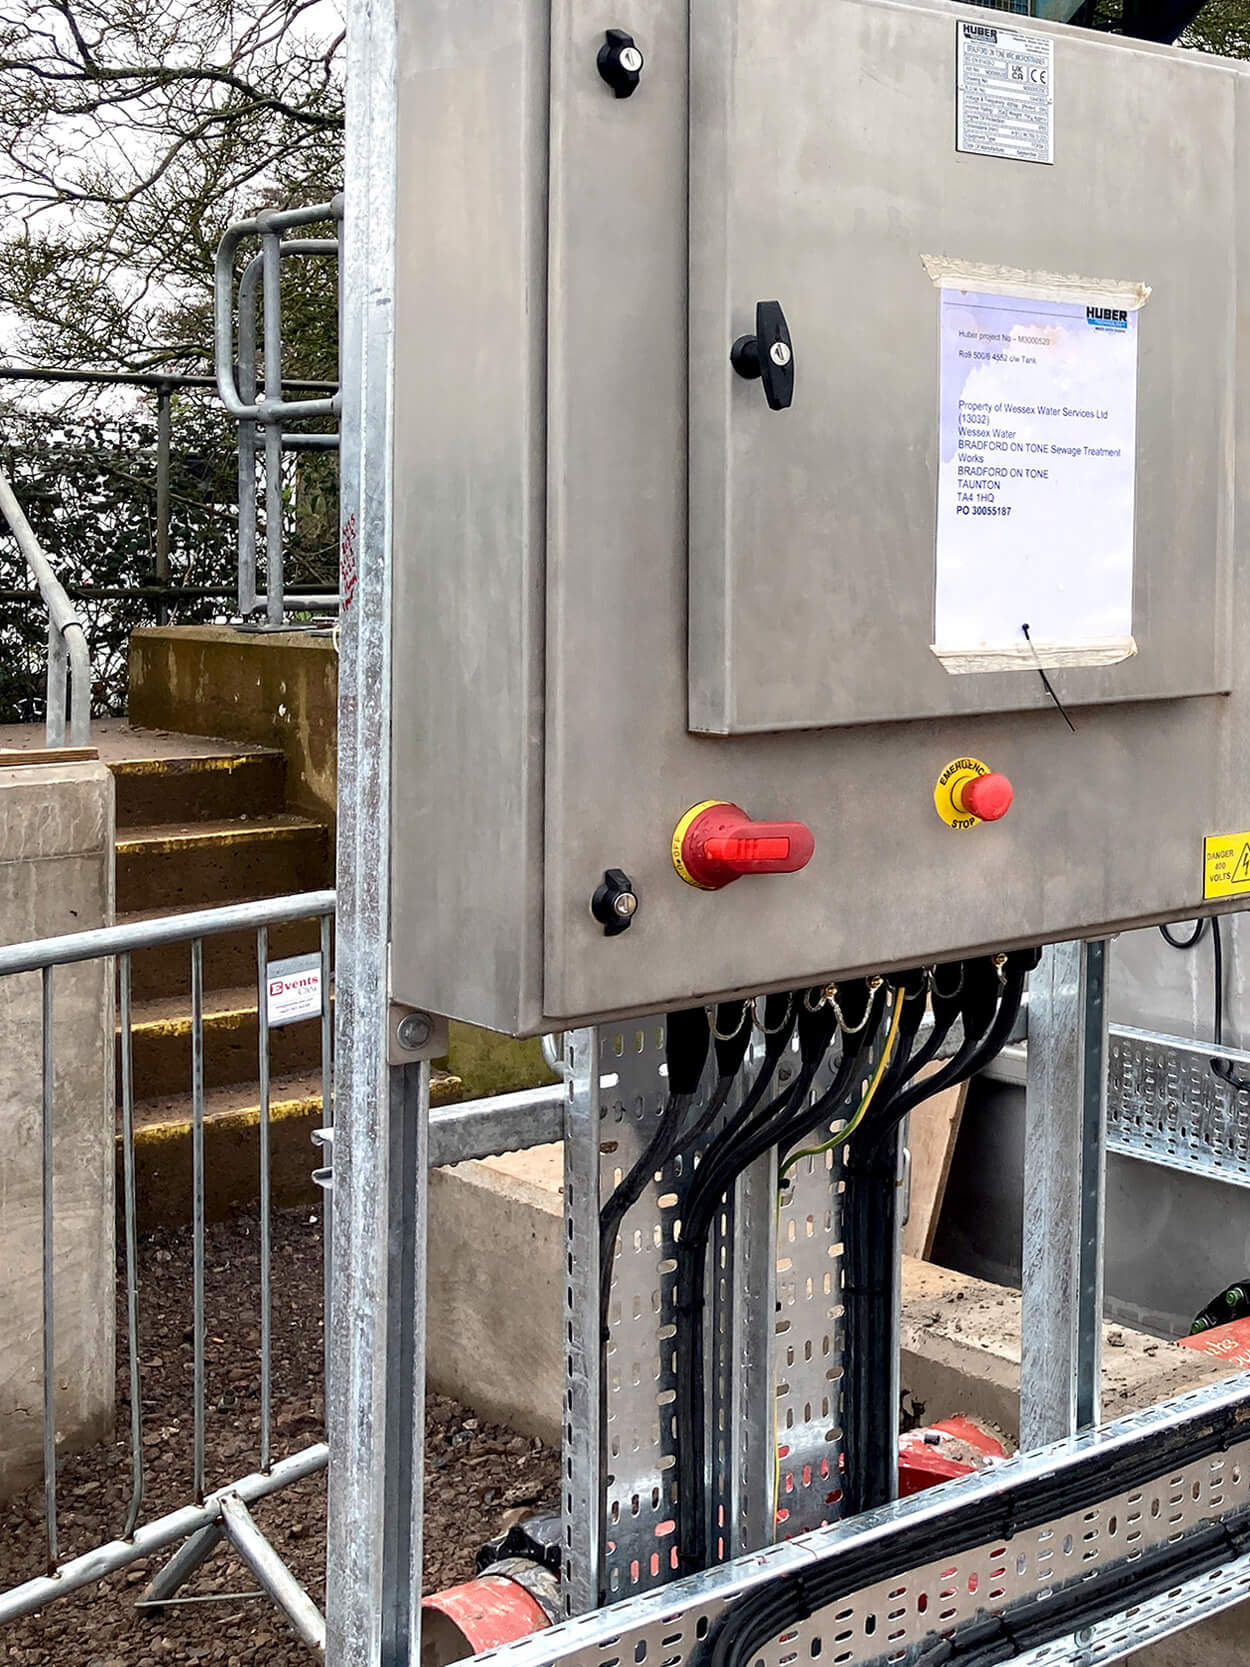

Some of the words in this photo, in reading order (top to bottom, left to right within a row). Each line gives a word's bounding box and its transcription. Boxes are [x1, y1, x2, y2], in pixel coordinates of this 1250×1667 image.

[963, 24, 998, 38] HUBER
[1086, 306, 1128, 322] HUBER
[958, 330, 978, 339] Huber
[979, 333, 1001, 343] project
[958, 400, 992, 414] Property
[994, 402, 1003, 412] of
[1004, 403, 1035, 414] Wessex
[1037, 406, 1060, 416] Water
[1062, 407, 1095, 418] Services
[1096, 409, 1109, 419] Ltd
[958, 412, 990, 426] (13032)
[958, 426, 991, 437] Wessex
[992, 428, 1016, 439] Water
[958, 439, 1009, 452] BRADFORD
[1010, 442, 1023, 452] ON
[1026, 443, 1049, 454] TONE
[1050, 444, 1082, 457] Sewage
[1083, 446, 1121, 457] Treatment
[958, 452, 985, 464] Works
[957, 465, 1008, 478] BRADFORD
[1009, 467, 1024, 478] ON
[1025, 468, 1049, 479] TONE
[957, 479, 1001, 490] TAUNTON
[957, 492, 974, 502] TA4
[976, 492, 995, 503] 1HQ
[956, 505, 970, 515] PO
[972, 506, 1012, 516] 30055187
[939, 759, 985, 786] EMERGENC
[951, 817, 976, 829] STOP
[1207, 849, 1234, 860] DANGER
[1209, 872, 1232, 882] VOLTS
[270, 976, 319, 997] Events
